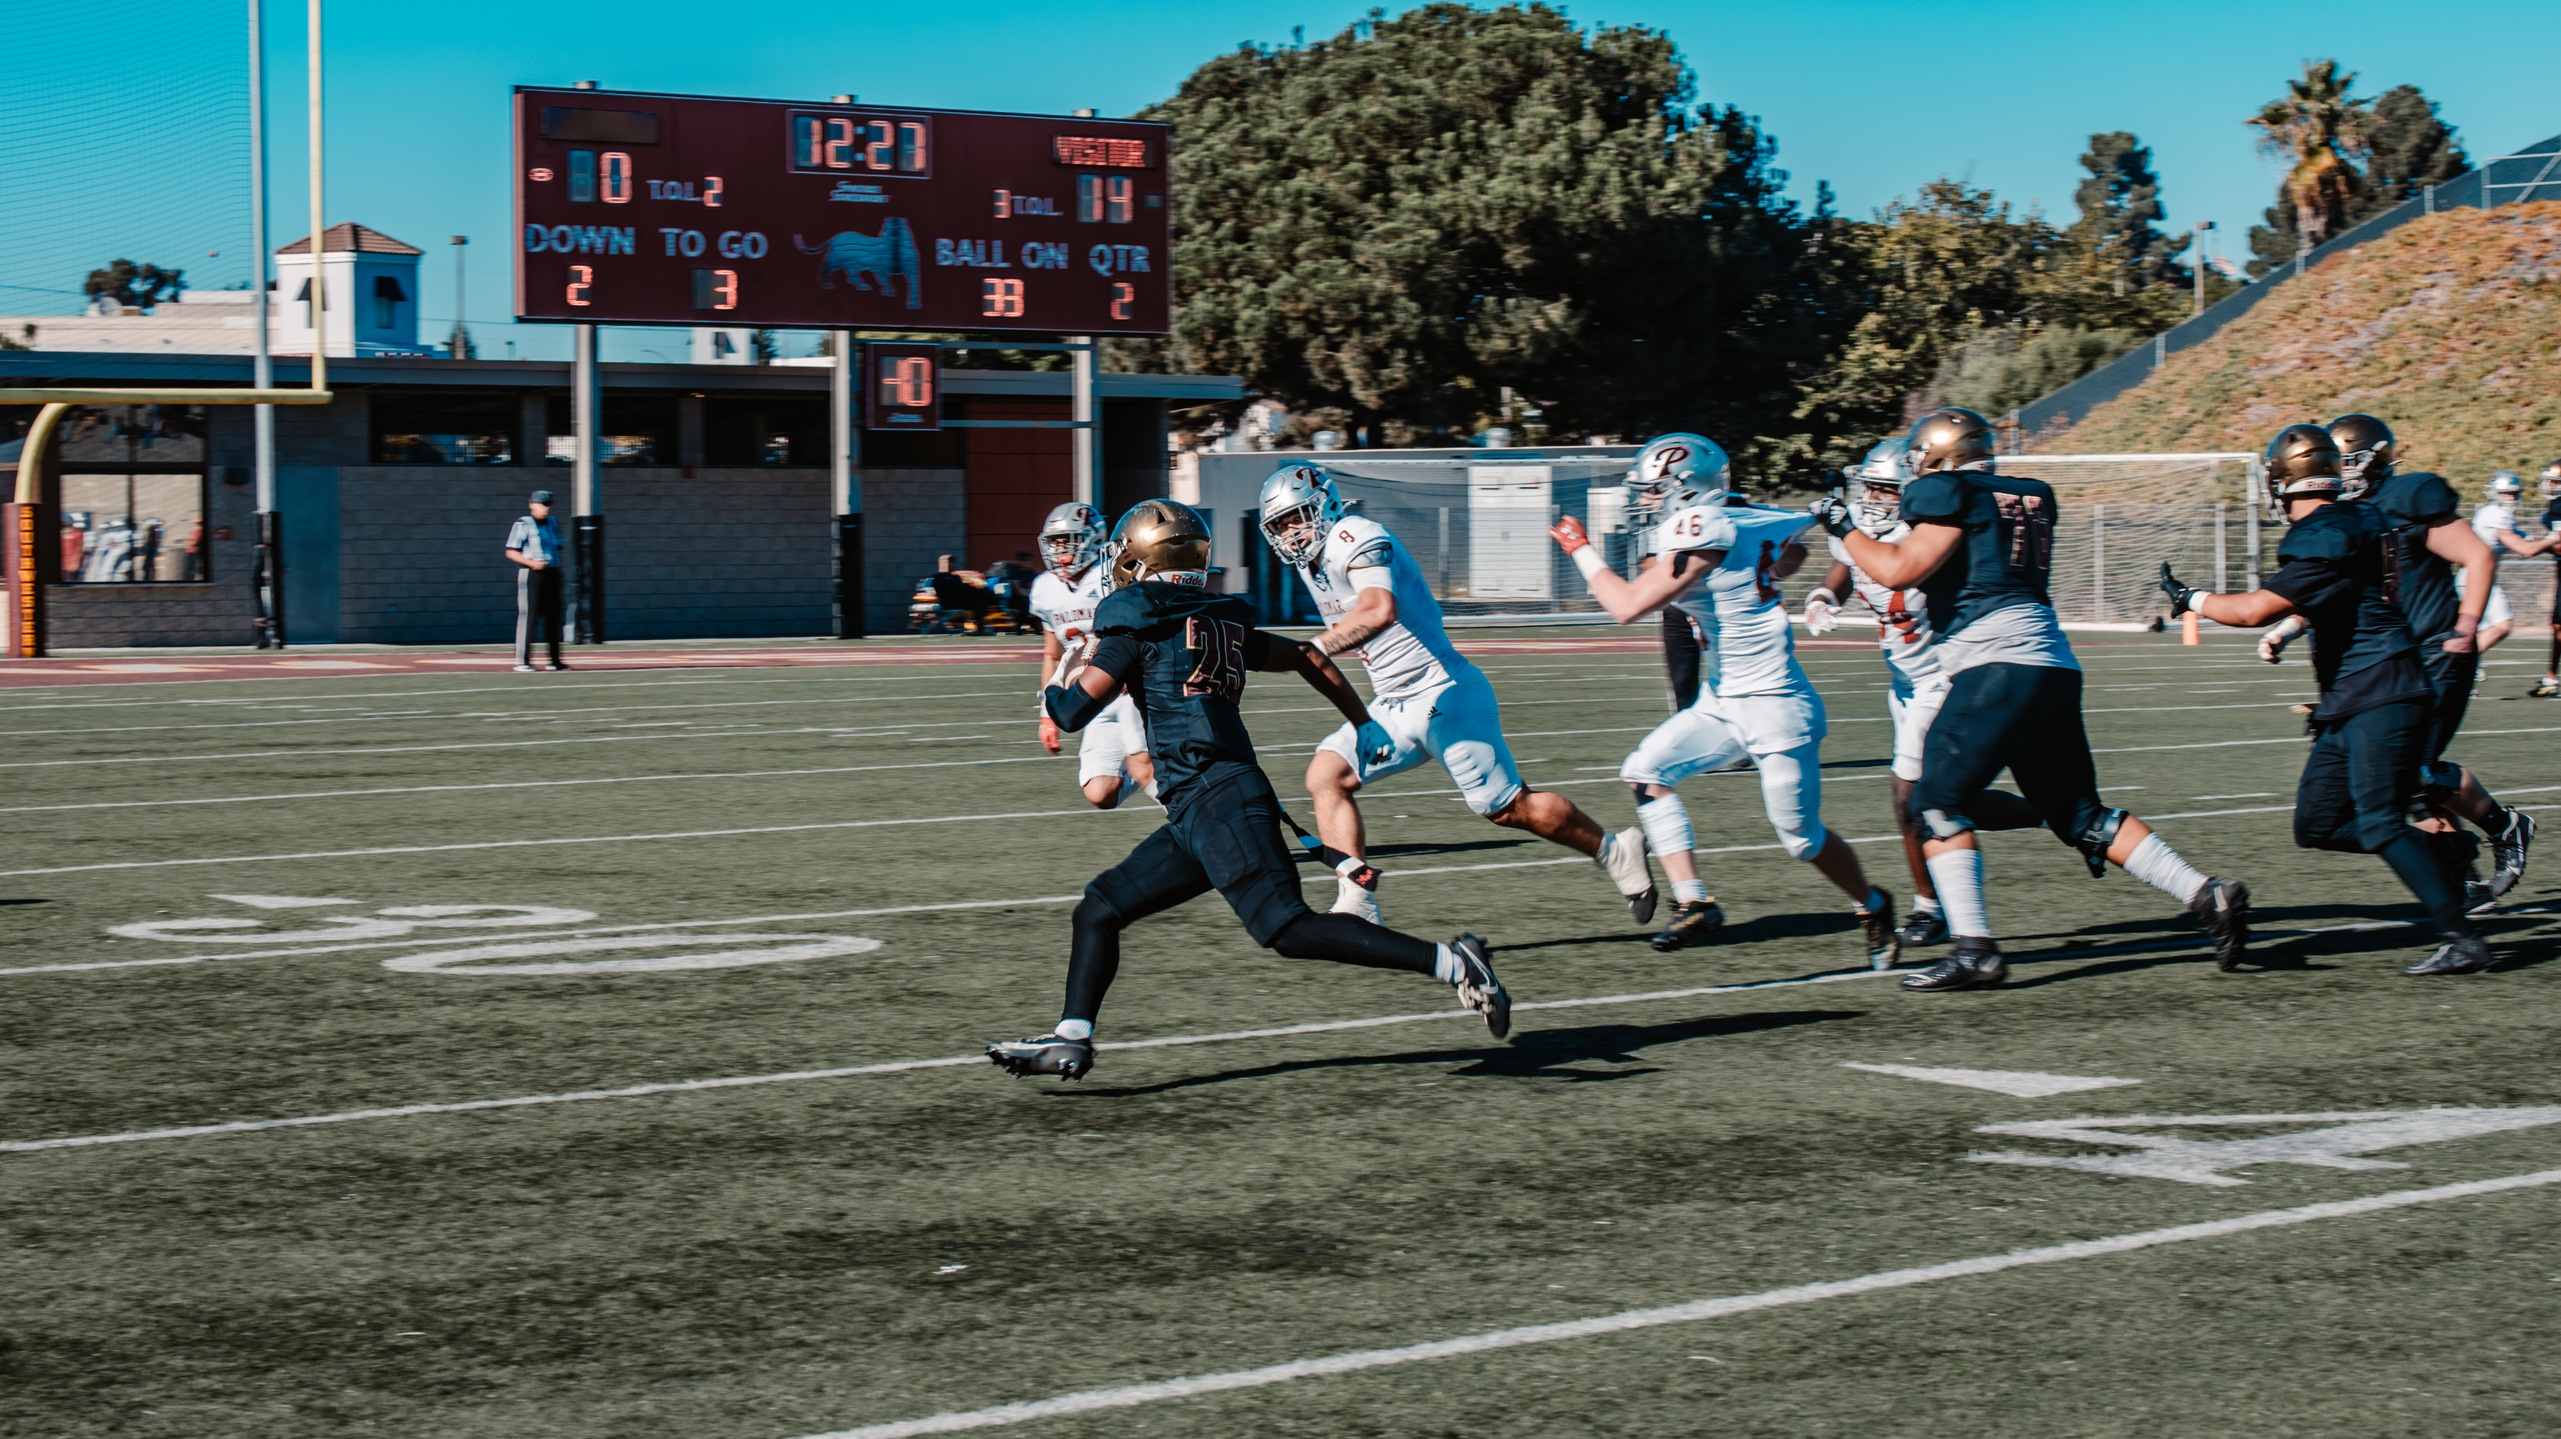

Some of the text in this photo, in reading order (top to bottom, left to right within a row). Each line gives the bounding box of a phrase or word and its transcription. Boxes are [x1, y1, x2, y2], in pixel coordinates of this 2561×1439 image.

[810, 118, 926, 170] 12:27
[600, 151, 632, 204] 0
[703, 176, 723, 207] 2
[993, 189, 1011, 218] 3
[1092, 177, 1134, 222] 14
[525, 223, 636, 255] DOWN
[658, 227, 769, 260] TO GO
[935, 238, 1069, 270] BALL ON
[1089, 244, 1151, 277] QTR
[566, 265, 593, 307] 2
[712, 269, 739, 310] 3
[1110, 282, 1134, 320] 2
[1653, 446, 1690, 479] P
[1339, 530, 1356, 543] 8
[1170, 573, 1205, 587] Ridde
[1183, 614, 1246, 704] 25
